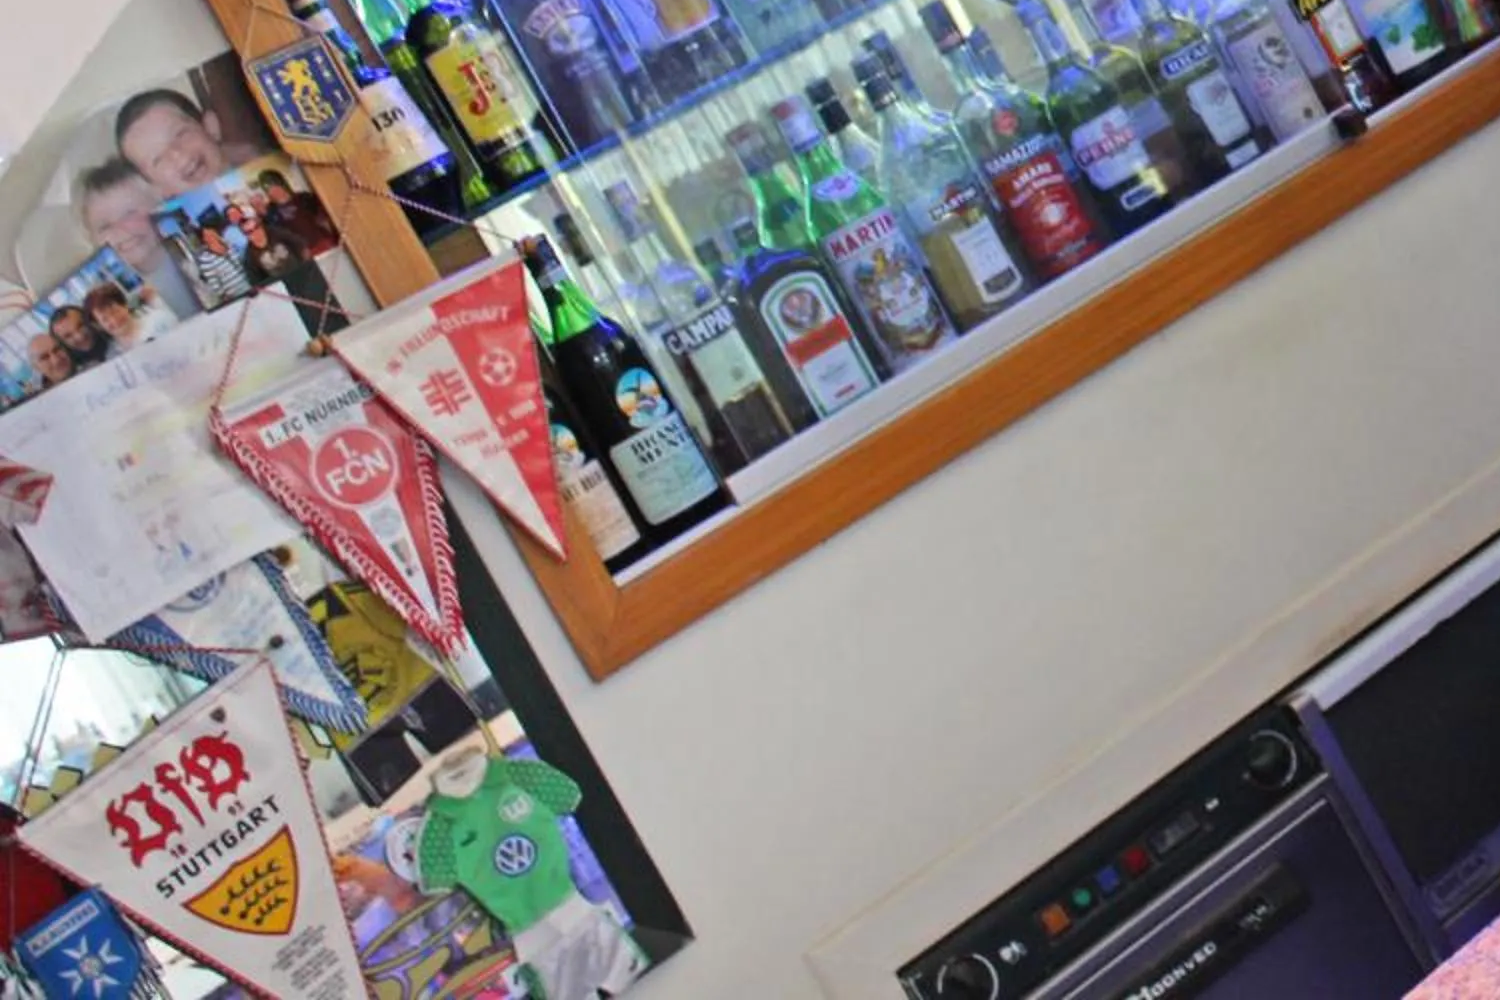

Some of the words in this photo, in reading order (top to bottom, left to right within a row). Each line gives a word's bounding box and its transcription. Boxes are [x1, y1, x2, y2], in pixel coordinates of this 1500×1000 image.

[281, 414, 304, 437] FC
[334, 437, 357, 461] 1.
[325, 448, 391, 496] FCN
[155, 795, 281, 899] STUTTGART
